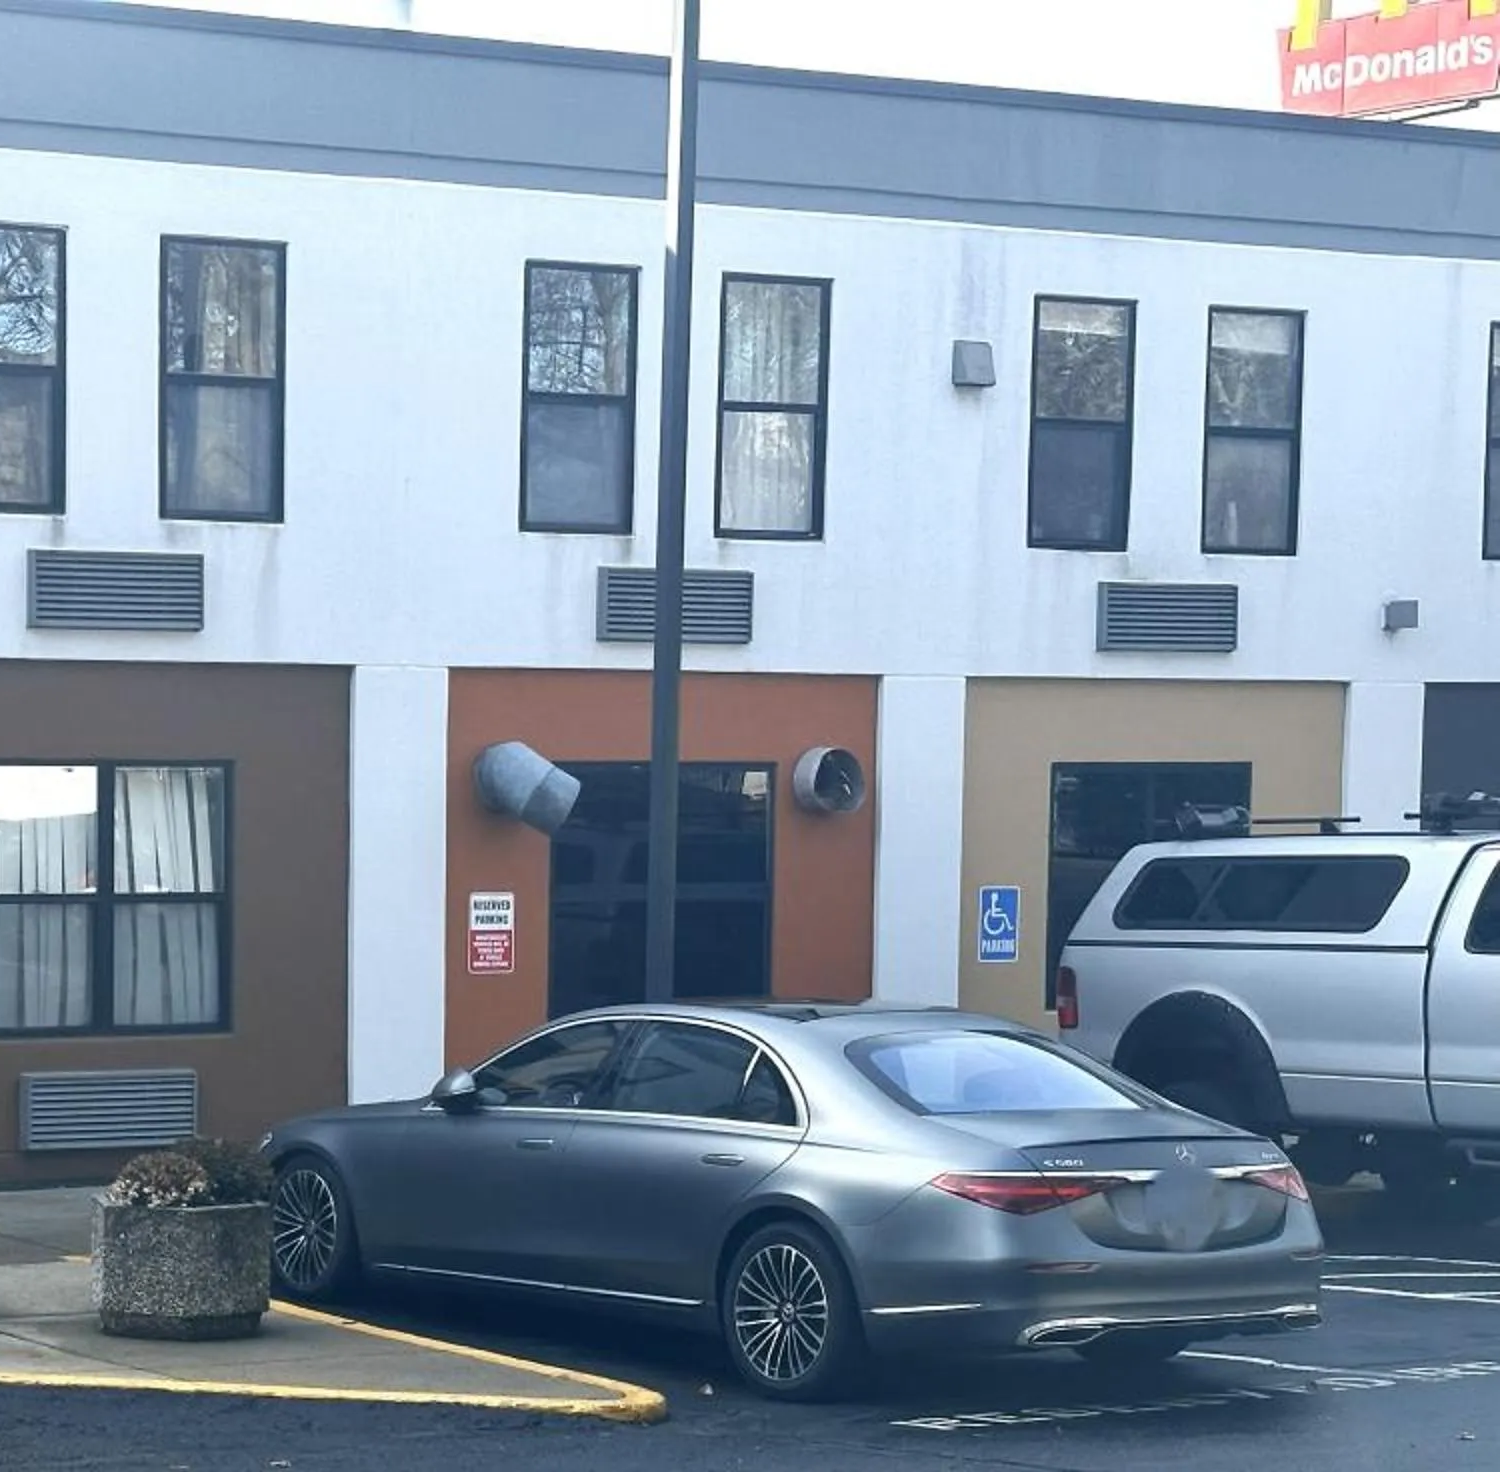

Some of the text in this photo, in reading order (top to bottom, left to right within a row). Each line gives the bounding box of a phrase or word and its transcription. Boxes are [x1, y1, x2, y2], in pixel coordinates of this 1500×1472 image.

[1292, 34, 1494, 96] McDonald's
[473, 900, 511, 911] RESERVED
[475, 914, 509, 925] PARKING
[981, 939, 1015, 954] PARKING
